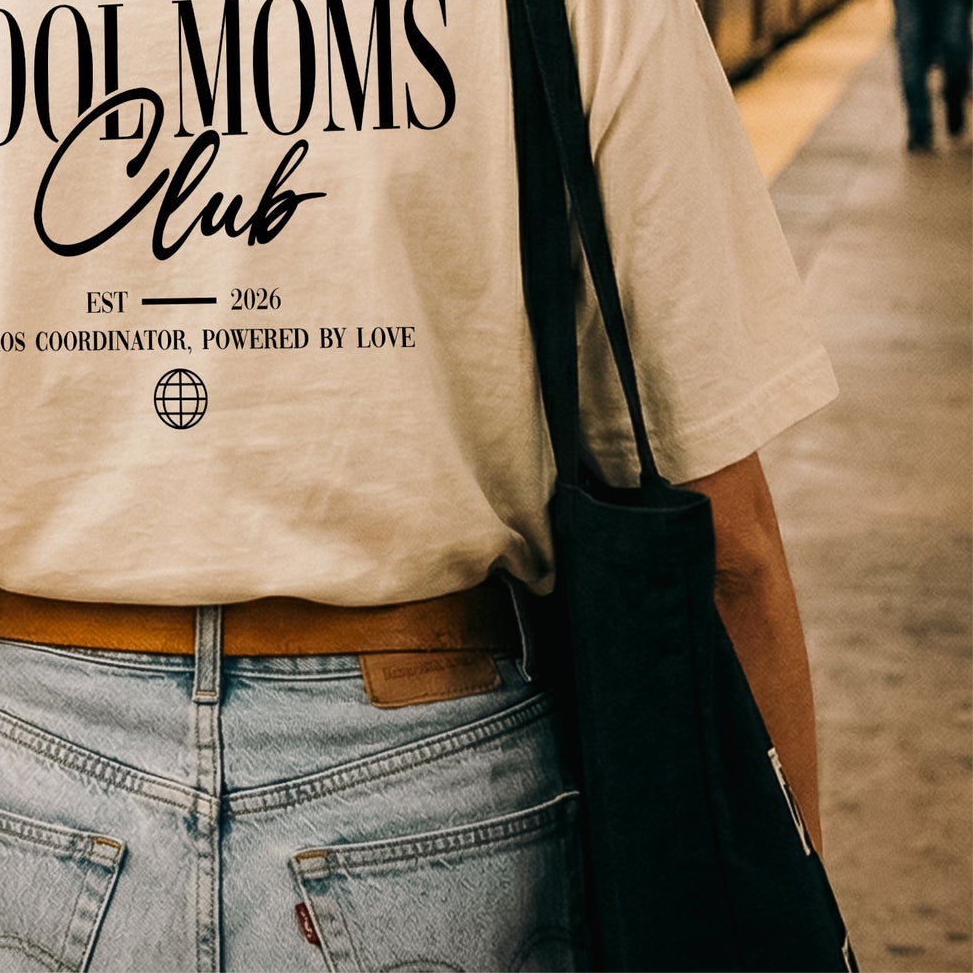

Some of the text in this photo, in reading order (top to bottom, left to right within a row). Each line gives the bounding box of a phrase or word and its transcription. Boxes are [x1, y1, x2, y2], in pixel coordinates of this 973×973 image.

[33, 87, 328, 262] Club
[86, 287, 283, 314] EST 2026
[35, 329, 193, 355] COORDINATOR,
[202, 328, 310, 351] POWERED
[319, 327, 346, 349] BY
[356, 326, 417, 349] LOVE
